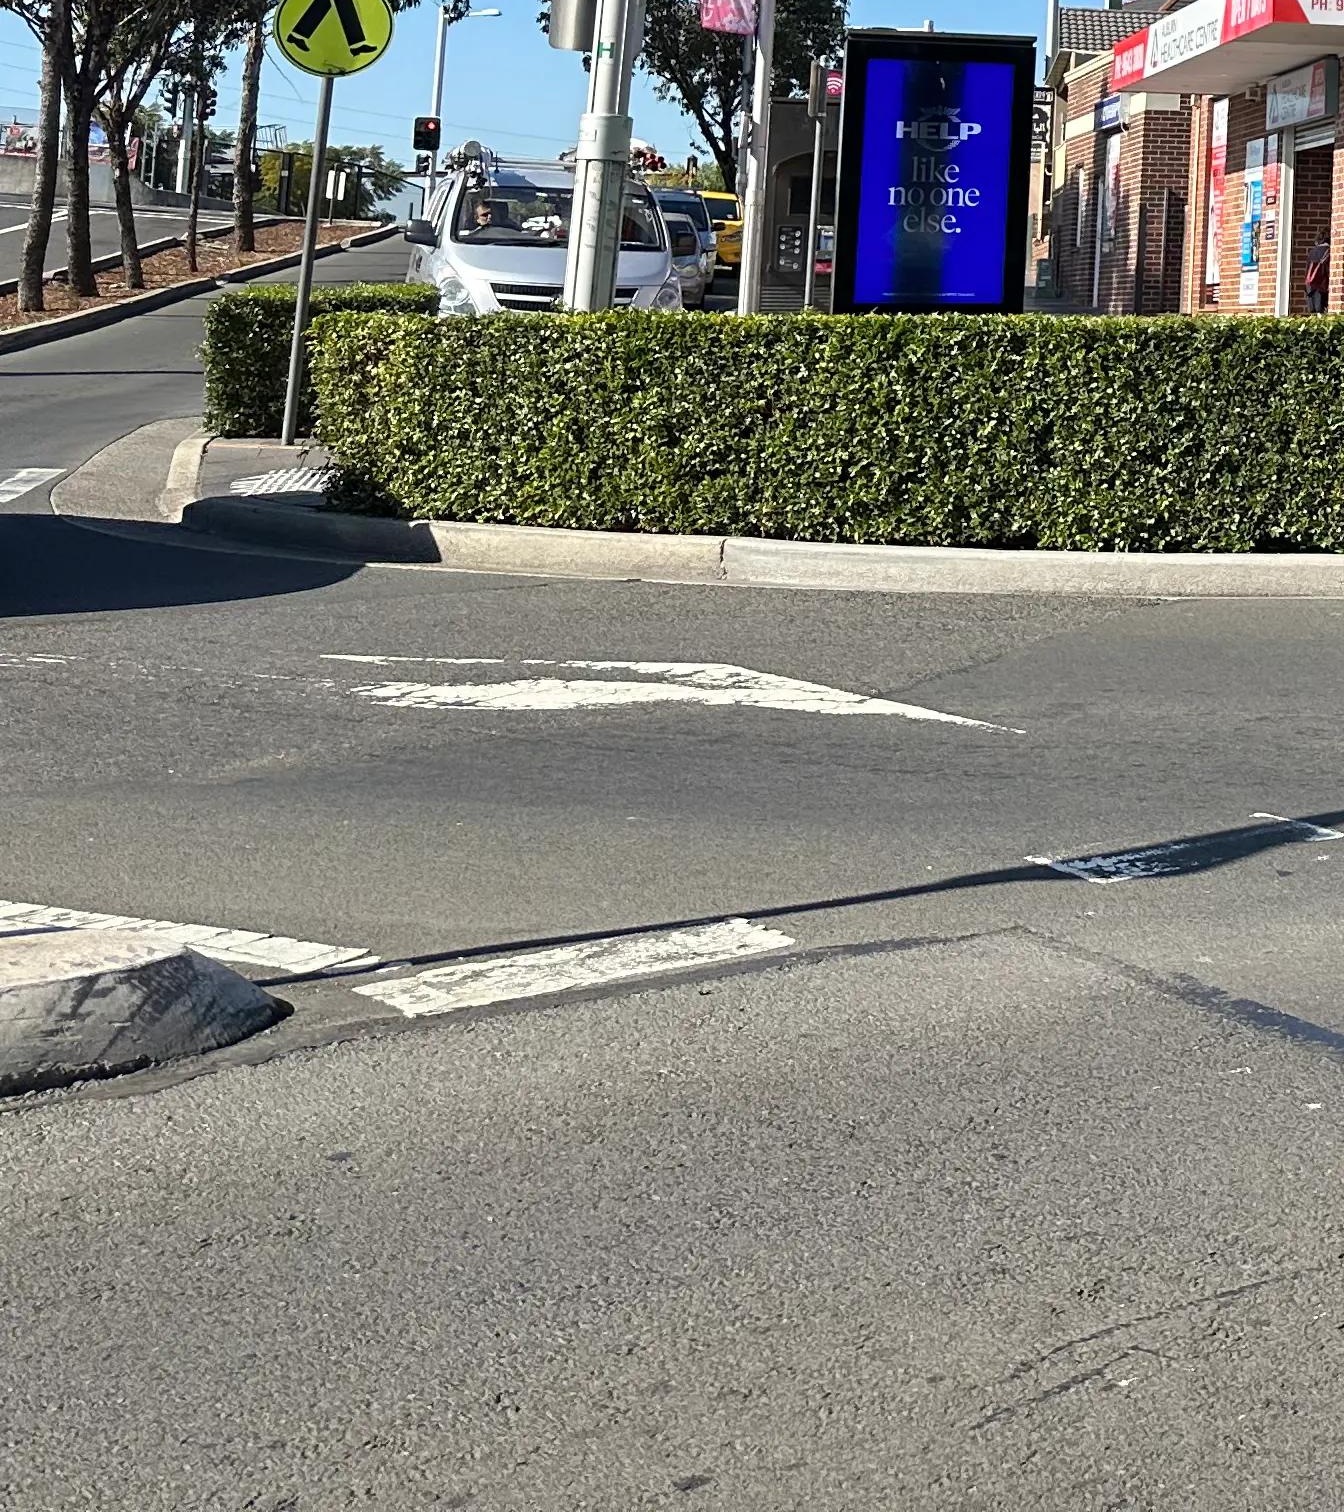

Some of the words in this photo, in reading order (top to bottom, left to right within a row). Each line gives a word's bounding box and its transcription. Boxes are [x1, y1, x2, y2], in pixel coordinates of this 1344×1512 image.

[598, 42, 615, 59] H
[895, 121, 982, 141] HELP
[911, 156, 960, 183] like
[888, 186, 925, 206] no
[930, 187, 980, 207] one
[903, 206, 962, 234] else.
